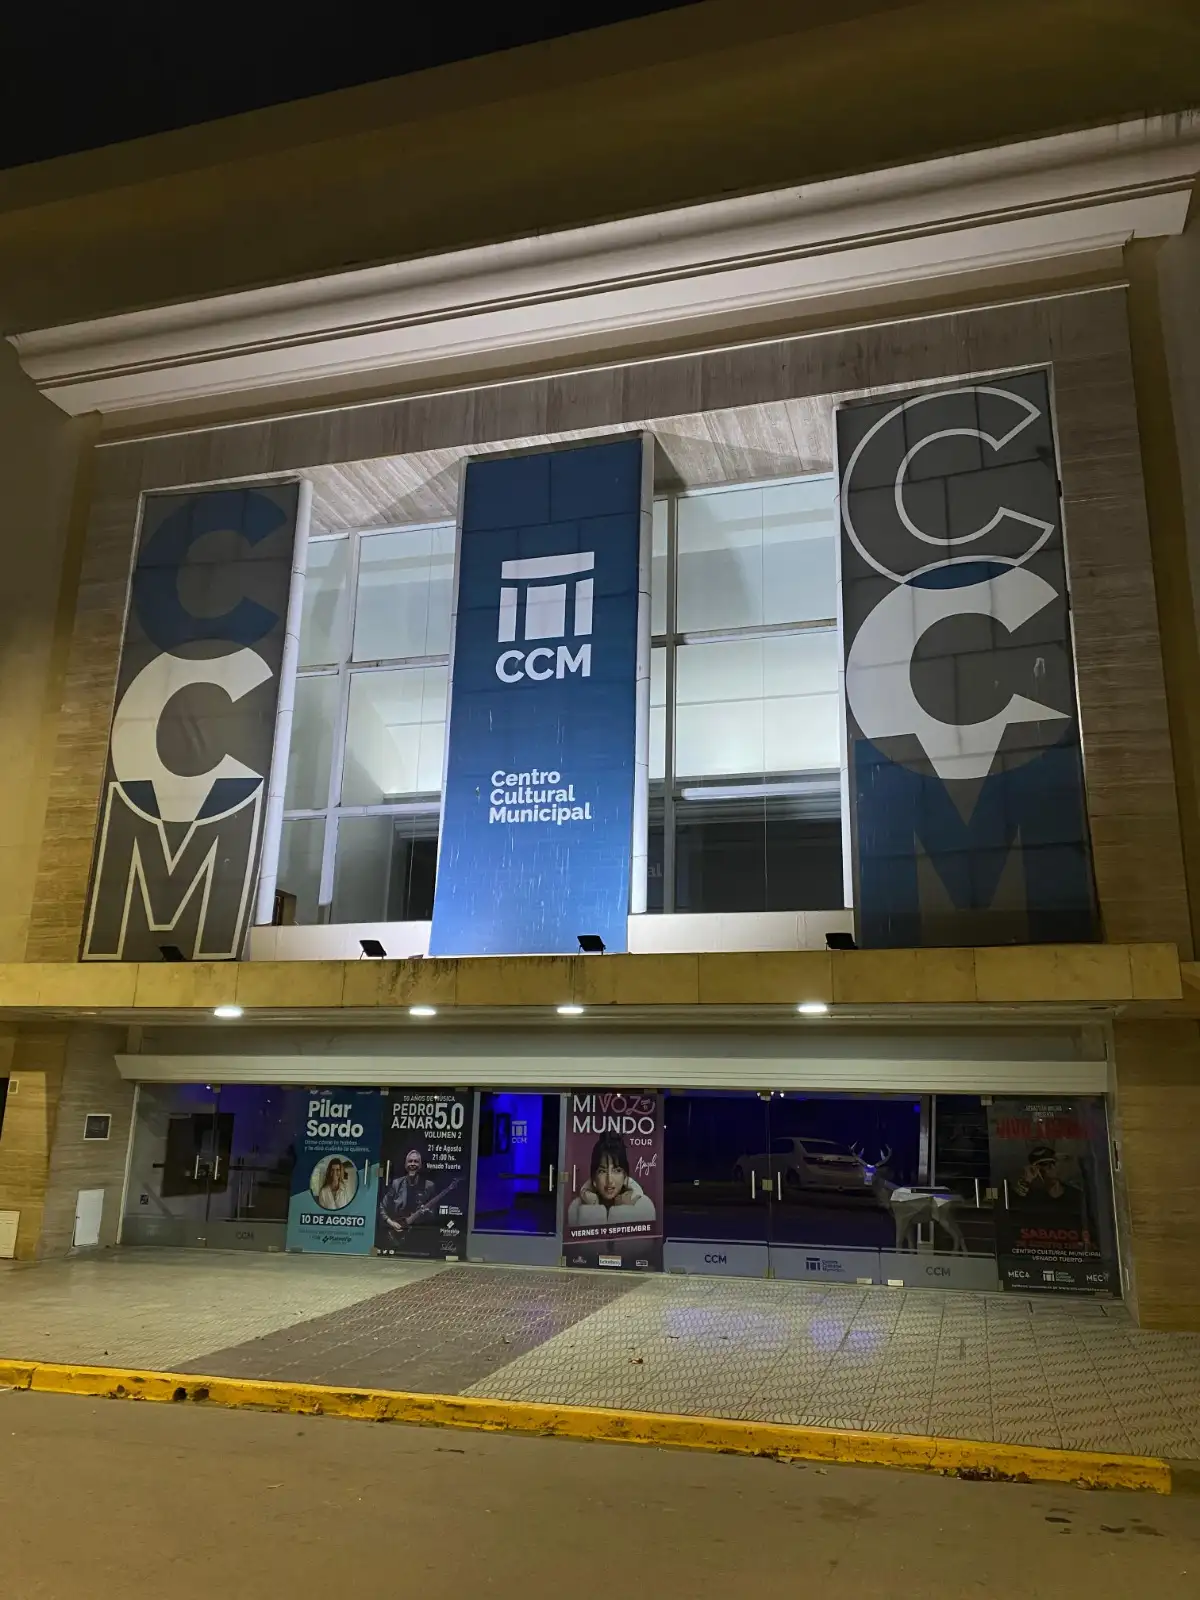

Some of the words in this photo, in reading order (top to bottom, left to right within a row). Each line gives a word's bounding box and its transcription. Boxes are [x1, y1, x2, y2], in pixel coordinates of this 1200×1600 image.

[495, 643, 592, 684] CCM
[491, 769, 561, 787] Centro
[489, 785, 576, 805] Cultural
[488, 802, 592, 826] Municipal
[307, 1098, 352, 1118] Pilar
[392, 1103, 434, 1116] PEDRO
[573, 1095, 596, 1113] MI
[598, 1093, 655, 1115] VOZ
[391, 1116, 433, 1129] AZNAR
[434, 1103, 464, 1130] 5.0
[306, 1120, 364, 1138] Sordo
[573, 1115, 655, 1135] MUNDO
[424, 1131, 457, 1139] VOLUMEN
[457, 1131, 462, 1139] 2
[629, 1138, 653, 1146] TOUR
[443, 1144, 462, 1153] Agosto
[301, 1214, 311, 1224] 10
[312, 1215, 324, 1225] DE
[325, 1216, 365, 1226] AGOSTO
[571, 1228, 599, 1238] VIERNES
[608, 1224, 651, 1234] SEPTIEMBRE
[704, 1254, 727, 1265] CCM
[925, 1266, 951, 1277] CCM
